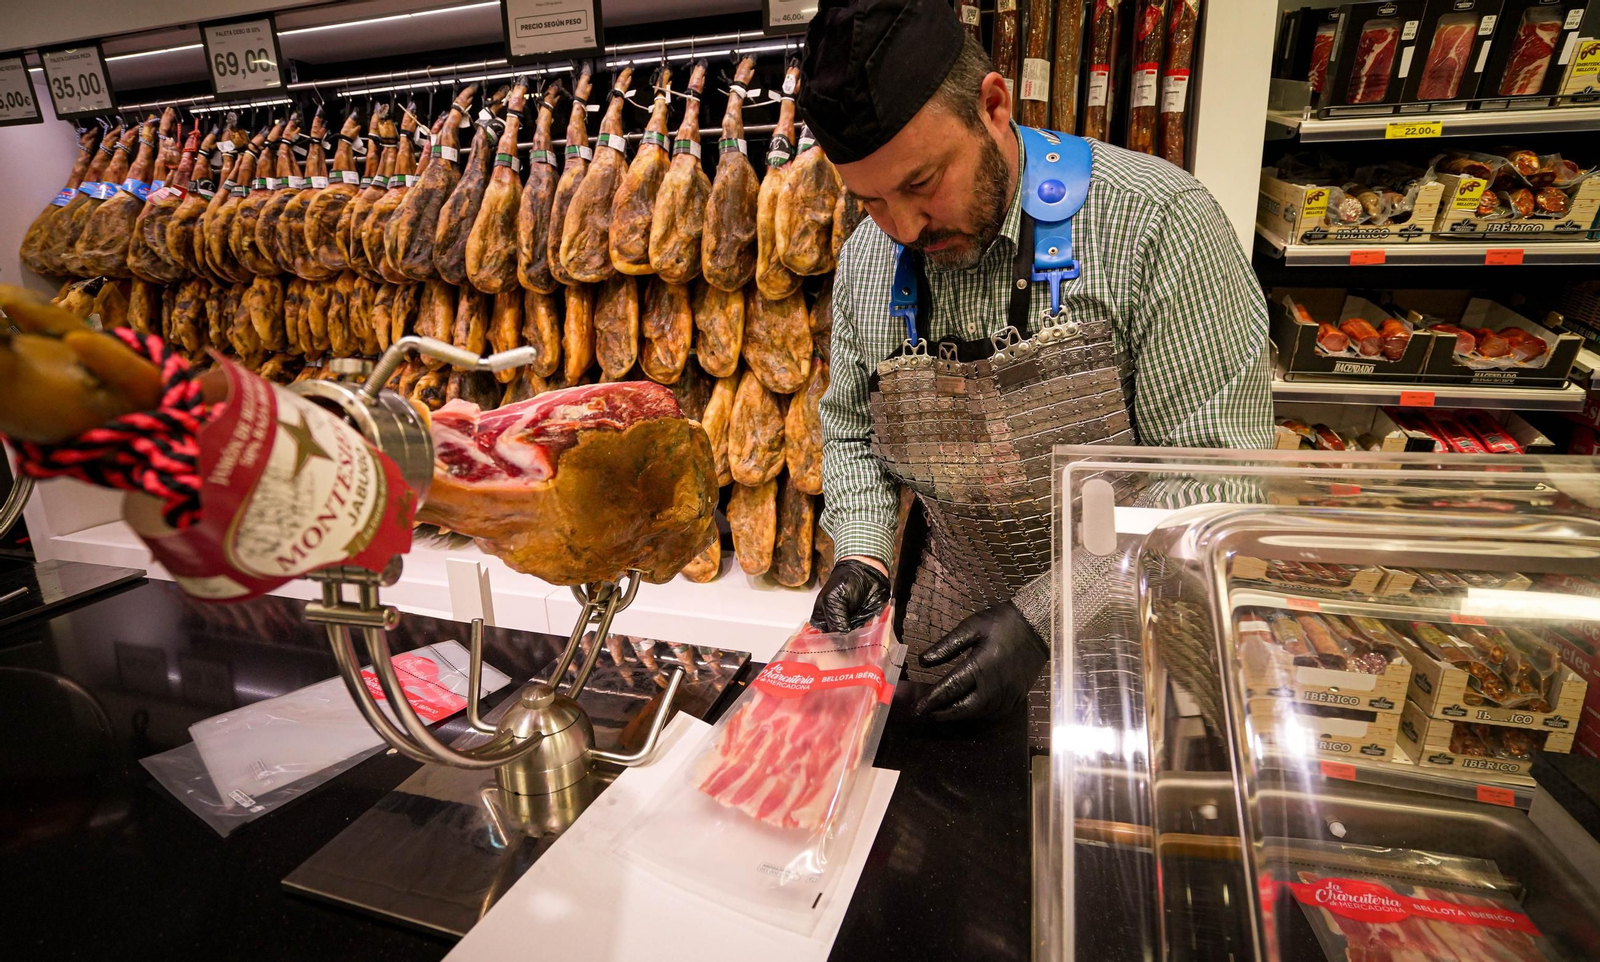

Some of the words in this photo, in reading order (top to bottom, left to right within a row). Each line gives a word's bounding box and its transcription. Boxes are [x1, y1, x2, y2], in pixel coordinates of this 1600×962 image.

[521, 23, 543, 31] PRECIO
[544, 19, 565, 28] SEGÚN
[1334, 363, 1375, 374] HACENDADO
[821, 674, 854, 682] BELLOTA
[766, 679, 811, 690] MERCADONA
[1304, 691, 1360, 706] IBÉRICO
[1463, 759, 1520, 773] IBÉRICO
[1339, 901, 1407, 914] MERCADONA
[1412, 904, 1467, 916] BELLOTA
